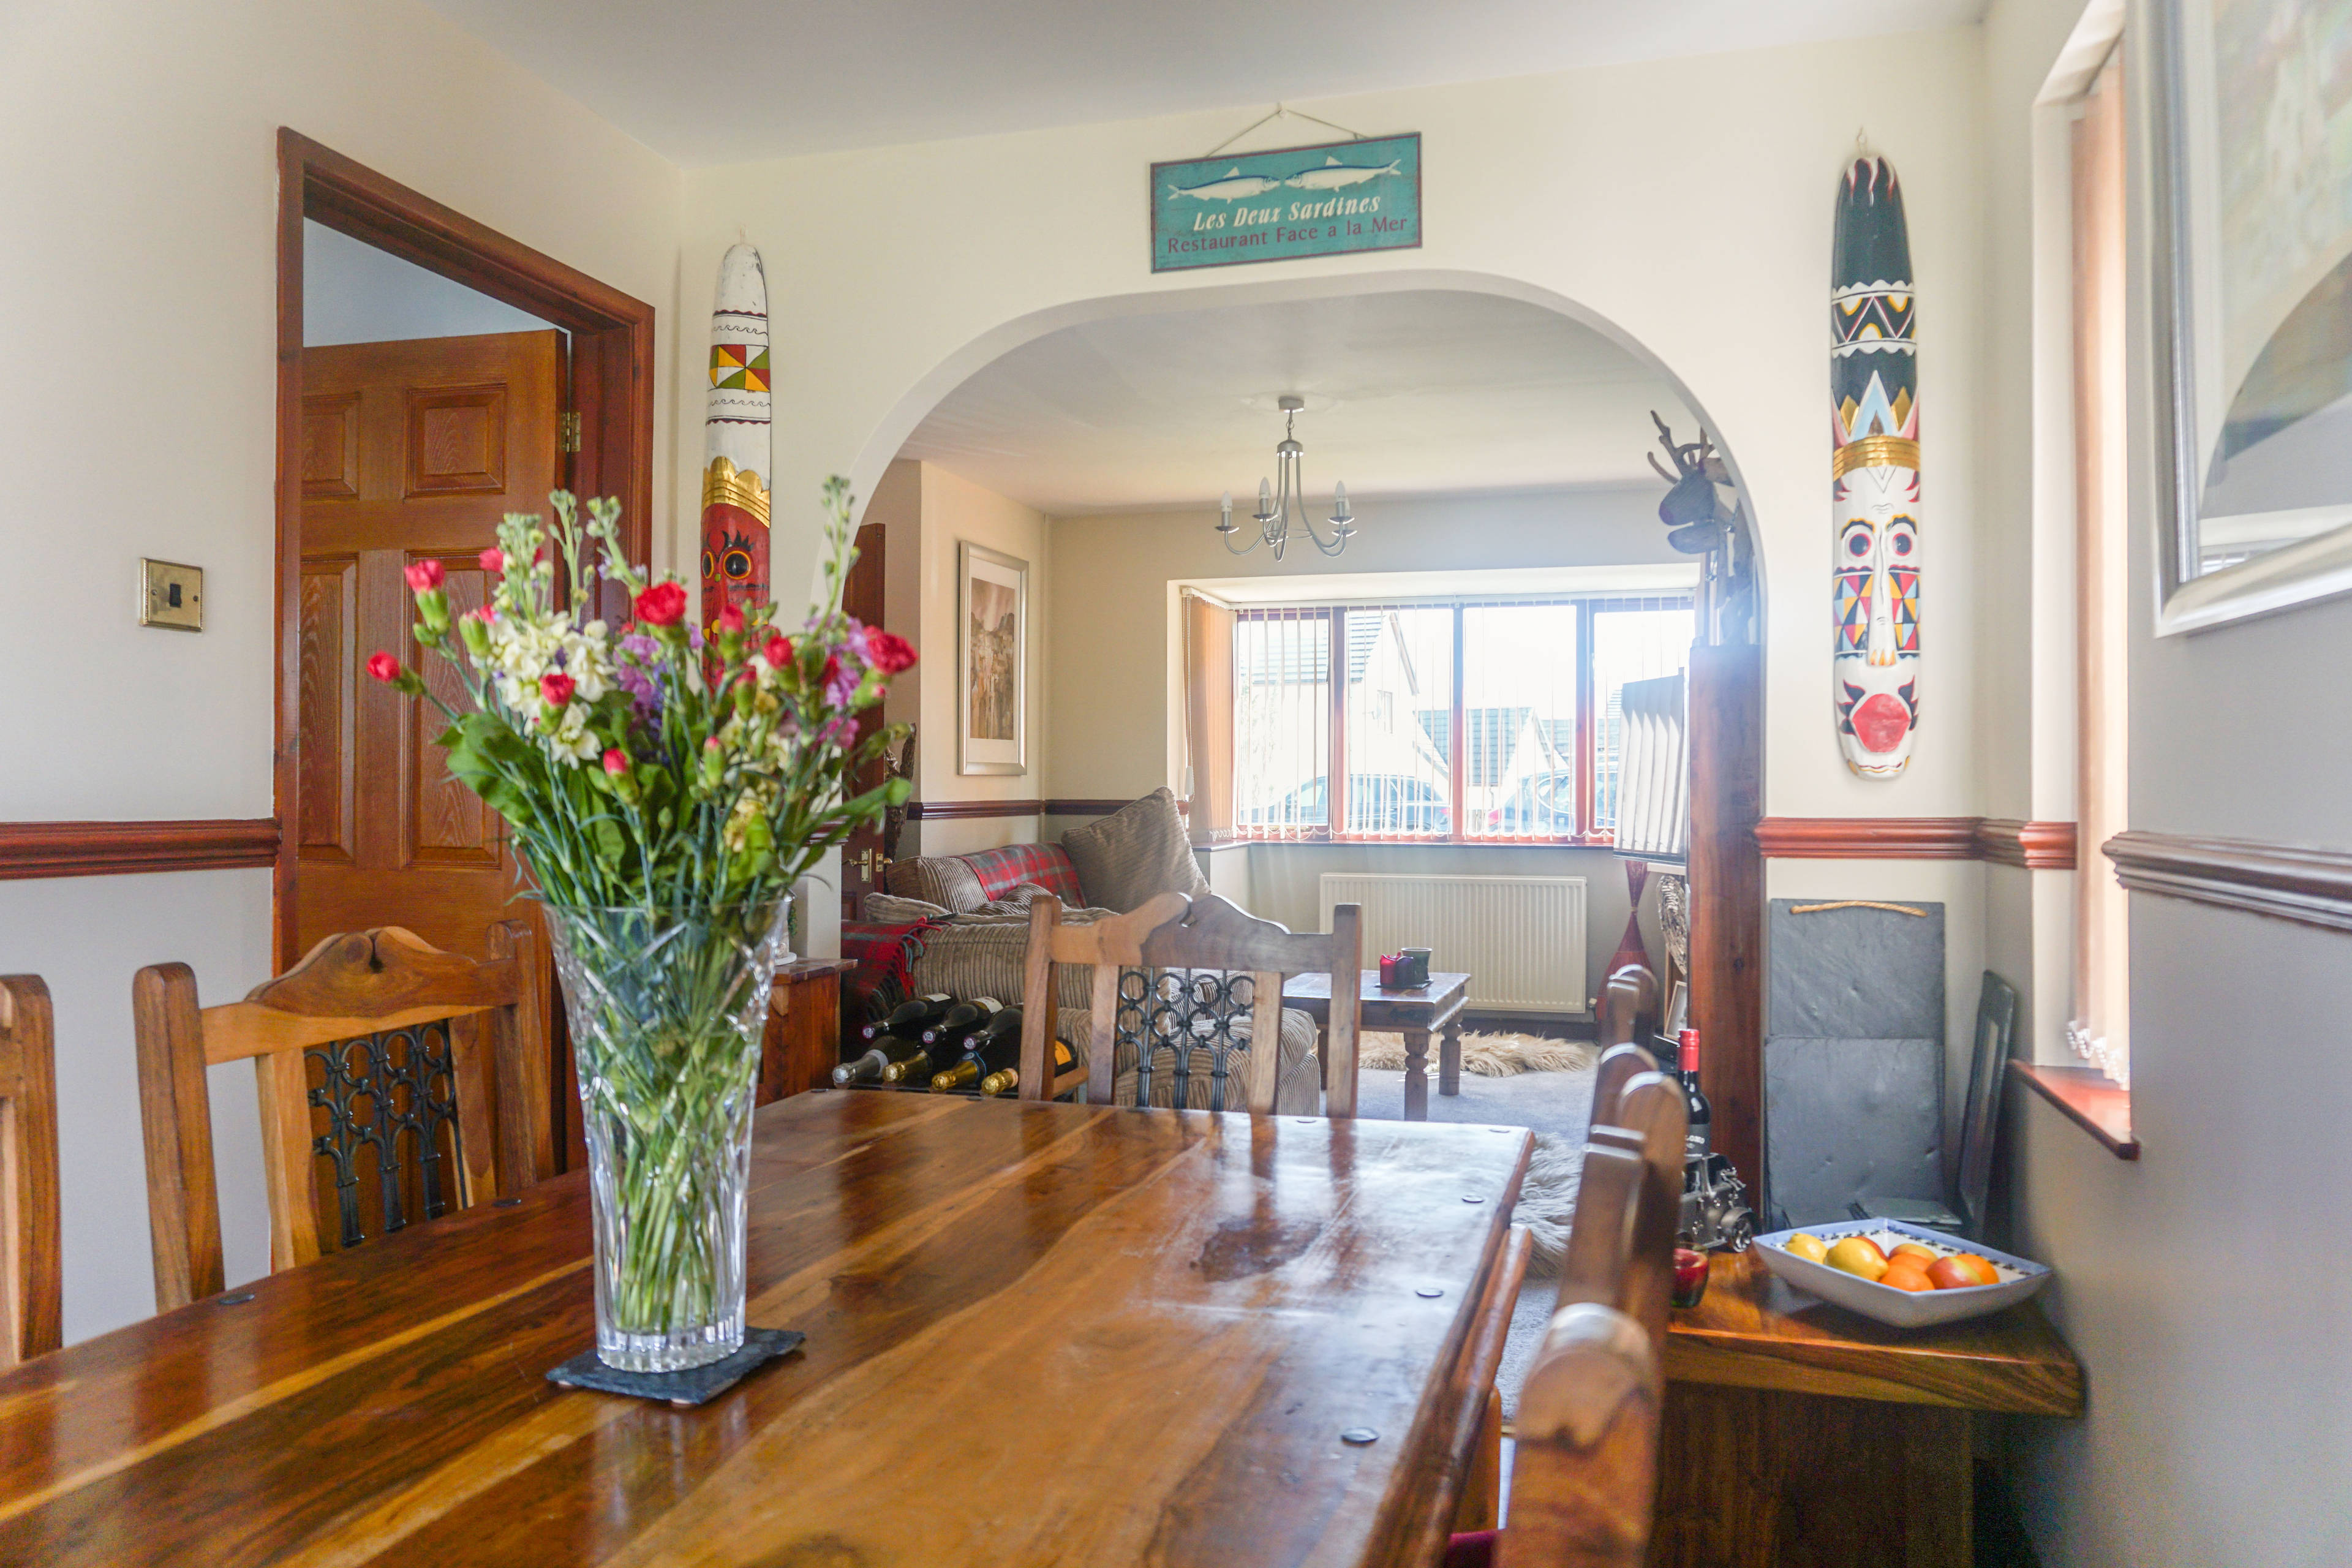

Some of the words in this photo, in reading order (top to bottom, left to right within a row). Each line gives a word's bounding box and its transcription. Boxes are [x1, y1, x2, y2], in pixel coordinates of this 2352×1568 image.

[1194, 211, 1225, 231] Les
[1233, 208, 1280, 227] Deux
[1288, 196, 1381, 221] Sardines
[1168, 231, 1267, 254] Restaurant
[1277, 226, 1317, 244] Face
[1348, 221, 1362, 235] la
[1372, 216, 1407, 232] Mer
